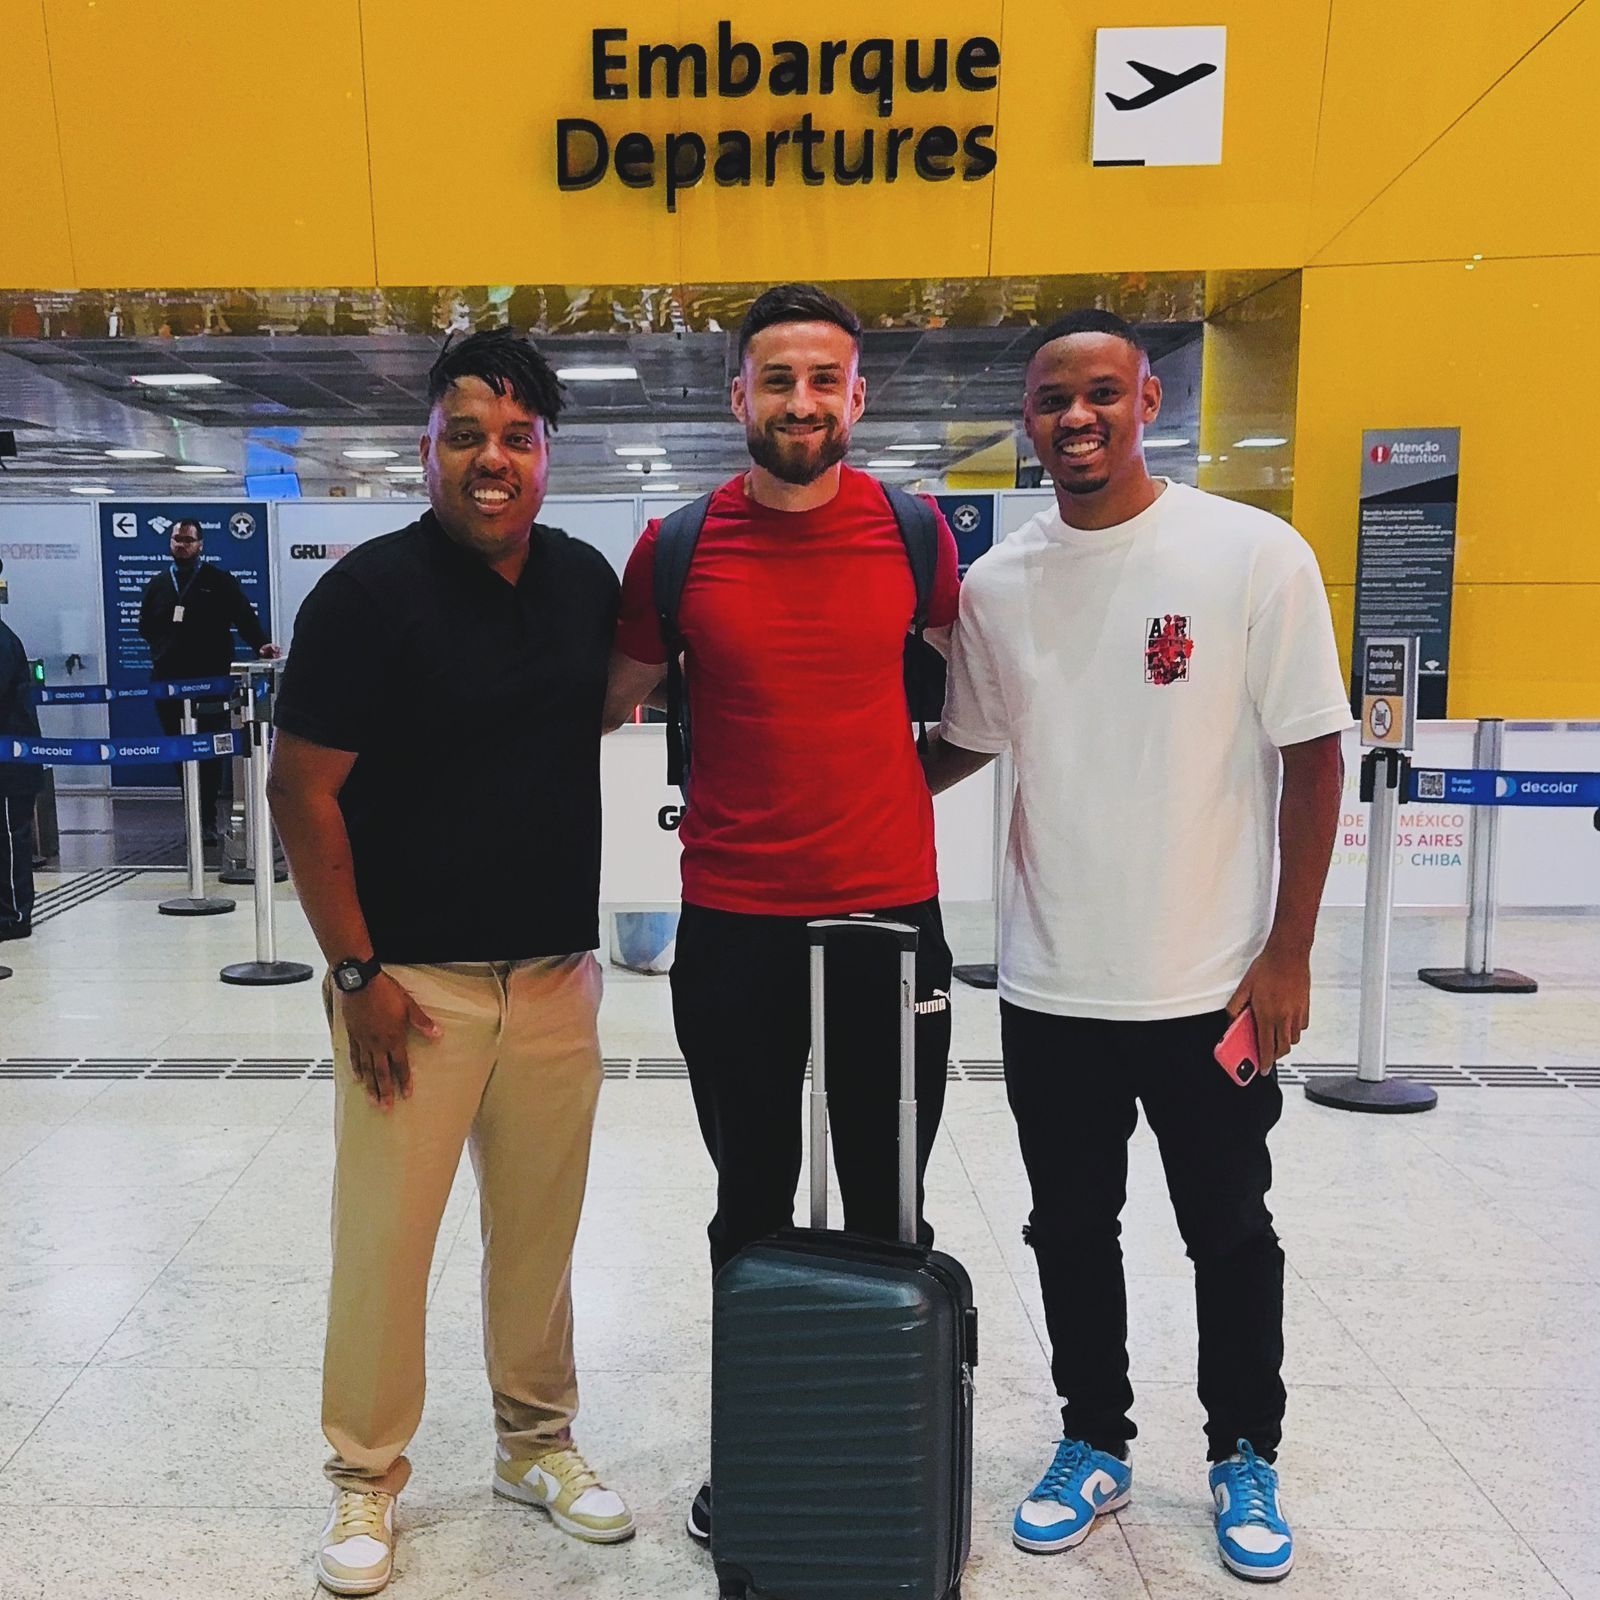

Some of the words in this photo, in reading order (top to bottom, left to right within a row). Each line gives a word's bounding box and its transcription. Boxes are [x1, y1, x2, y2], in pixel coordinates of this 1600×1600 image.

[592, 20, 1000, 117] Embarque
[556, 112, 998, 213] Departures
[1391, 441, 1440, 454] Atenção
[1390, 453, 1446, 465] Attention
[31, 745, 73, 756] decolar
[119, 745, 160, 756] decolar
[1521, 781, 1579, 794] decolar
[1400, 811, 1464, 828] MÉXICO
[1417, 834, 1463, 847] AIRES
[1411, 854, 1462, 866] CHIBA
